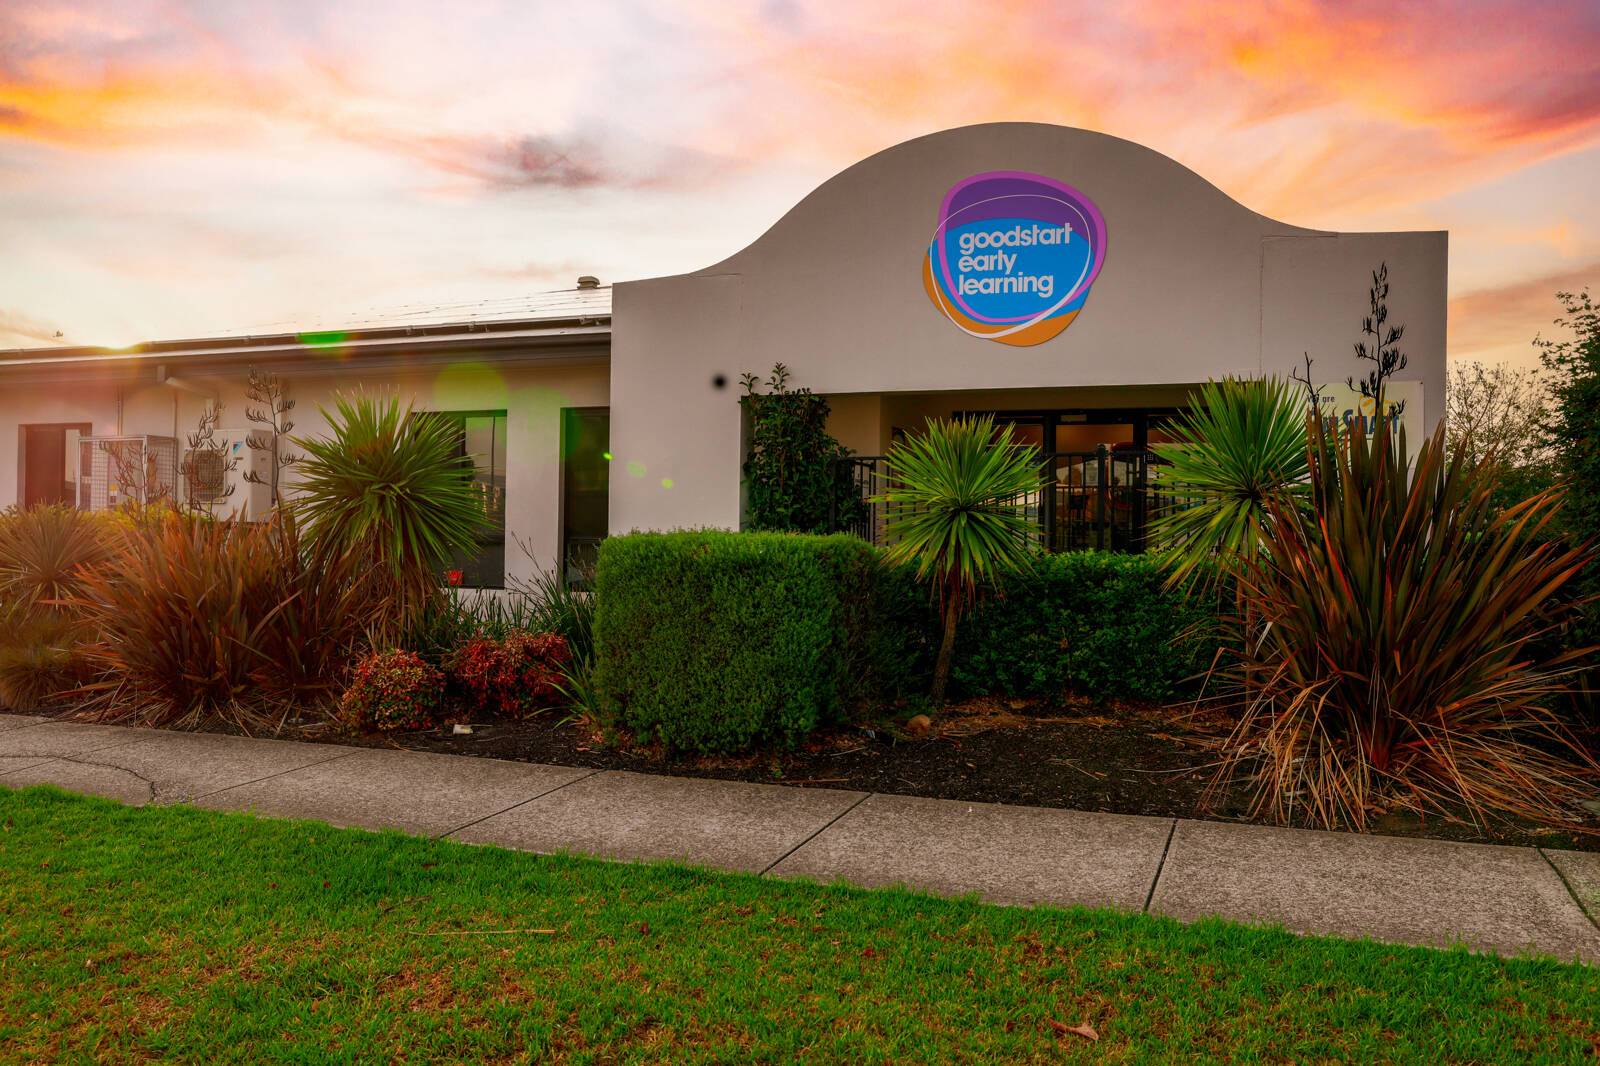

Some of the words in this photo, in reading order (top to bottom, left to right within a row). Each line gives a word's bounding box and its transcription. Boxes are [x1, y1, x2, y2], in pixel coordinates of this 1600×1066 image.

[959, 222, 1073, 255] goodstart
[958, 249, 1017, 275] early
[958, 272, 1054, 298] learning
